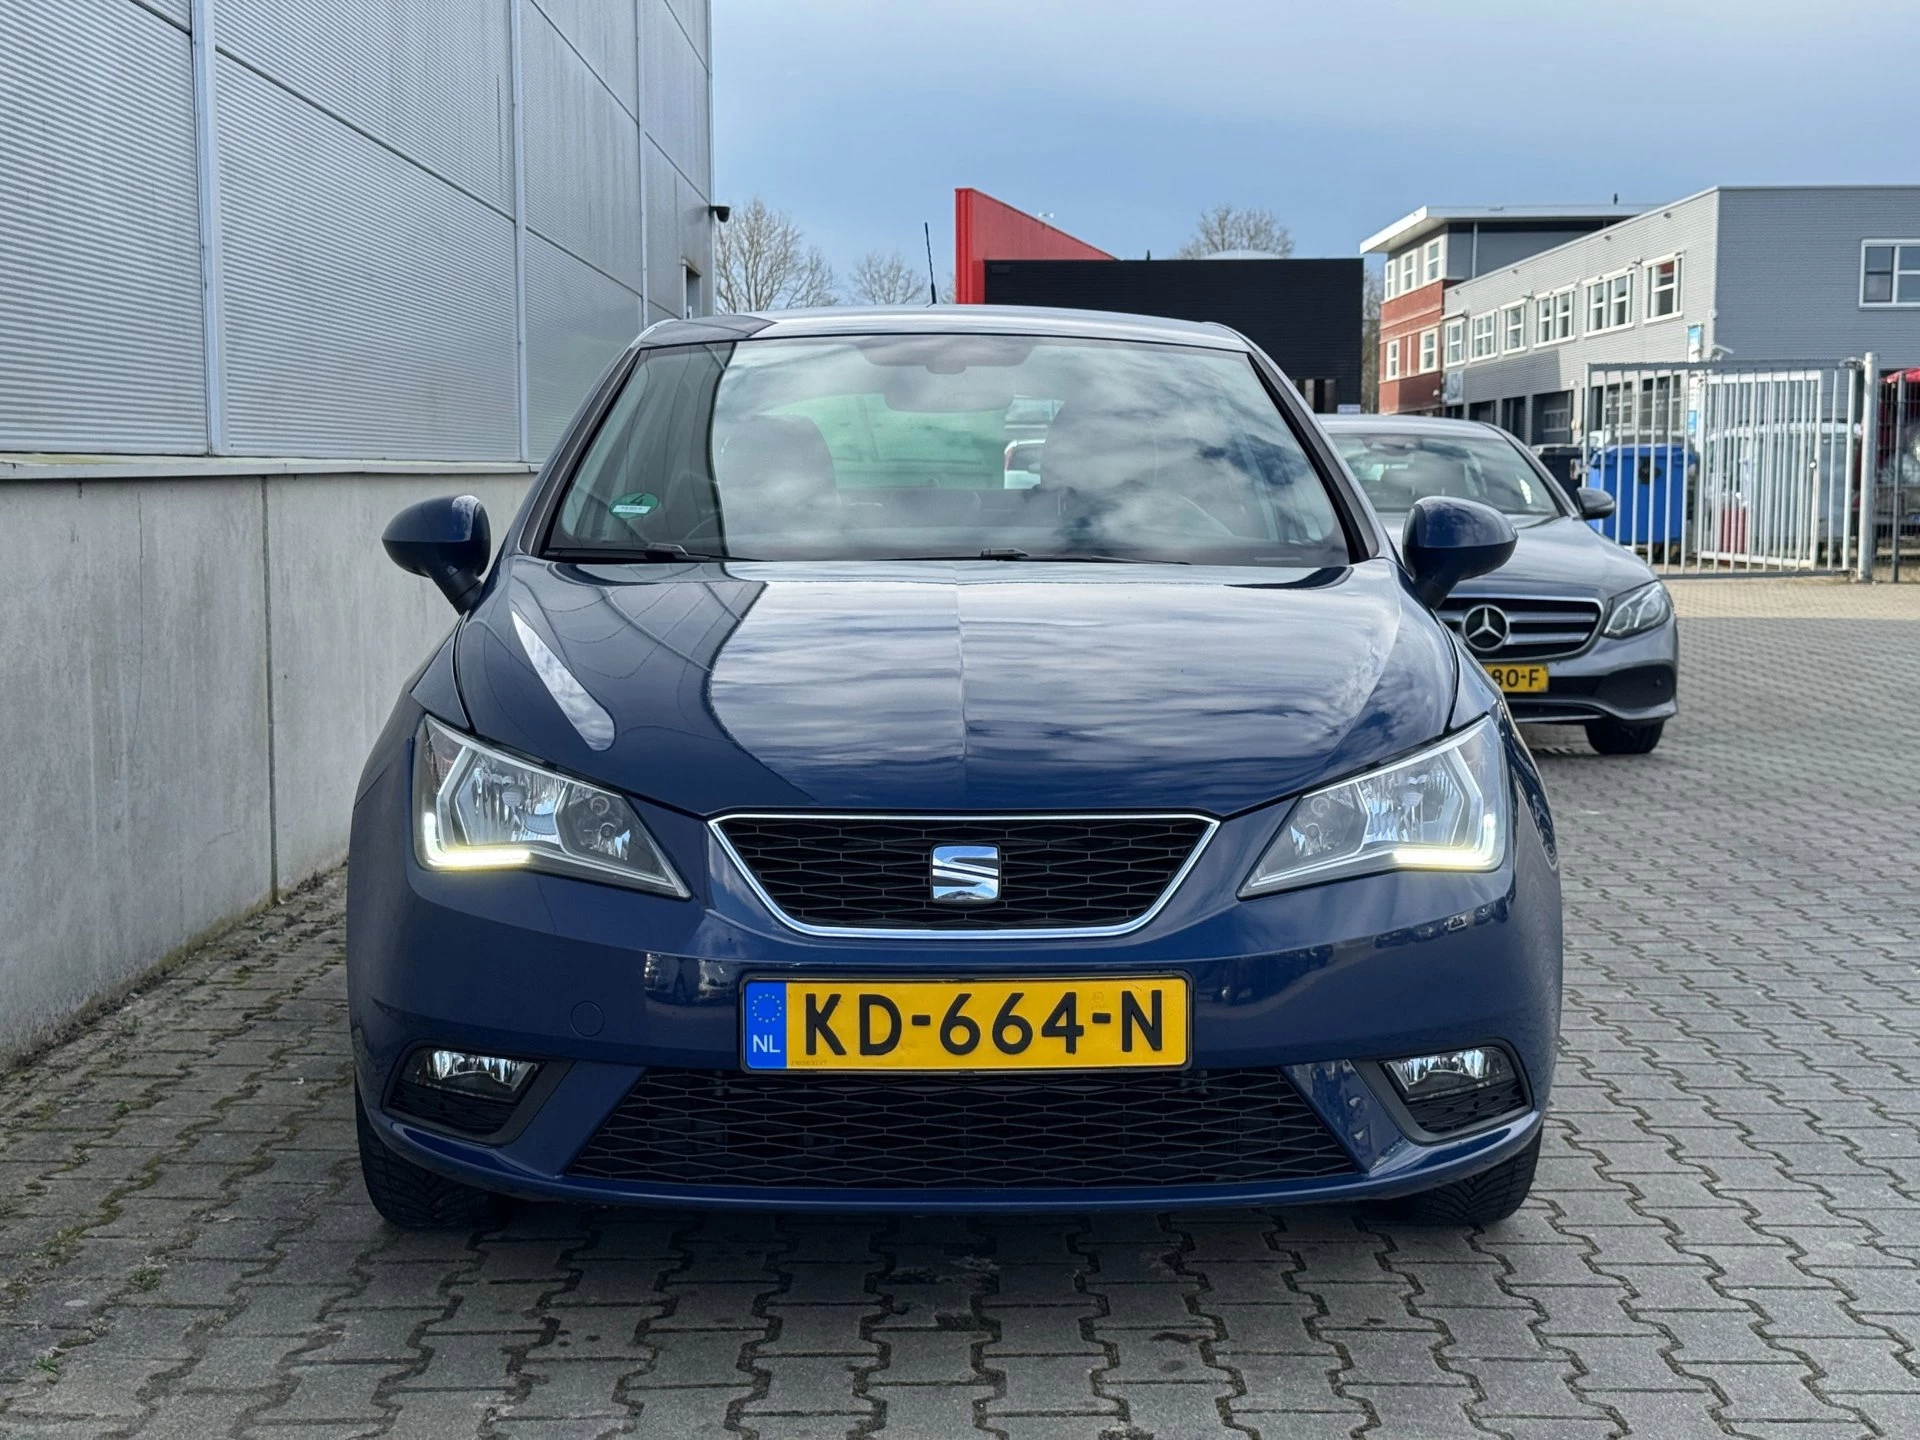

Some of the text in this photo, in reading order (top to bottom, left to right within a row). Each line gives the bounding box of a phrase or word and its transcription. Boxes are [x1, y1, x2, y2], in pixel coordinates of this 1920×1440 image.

[1492, 669, 1540, 688] 80-F
[805, 989, 1162, 1055] KD-664-N
[753, 1035, 780, 1053] NL
